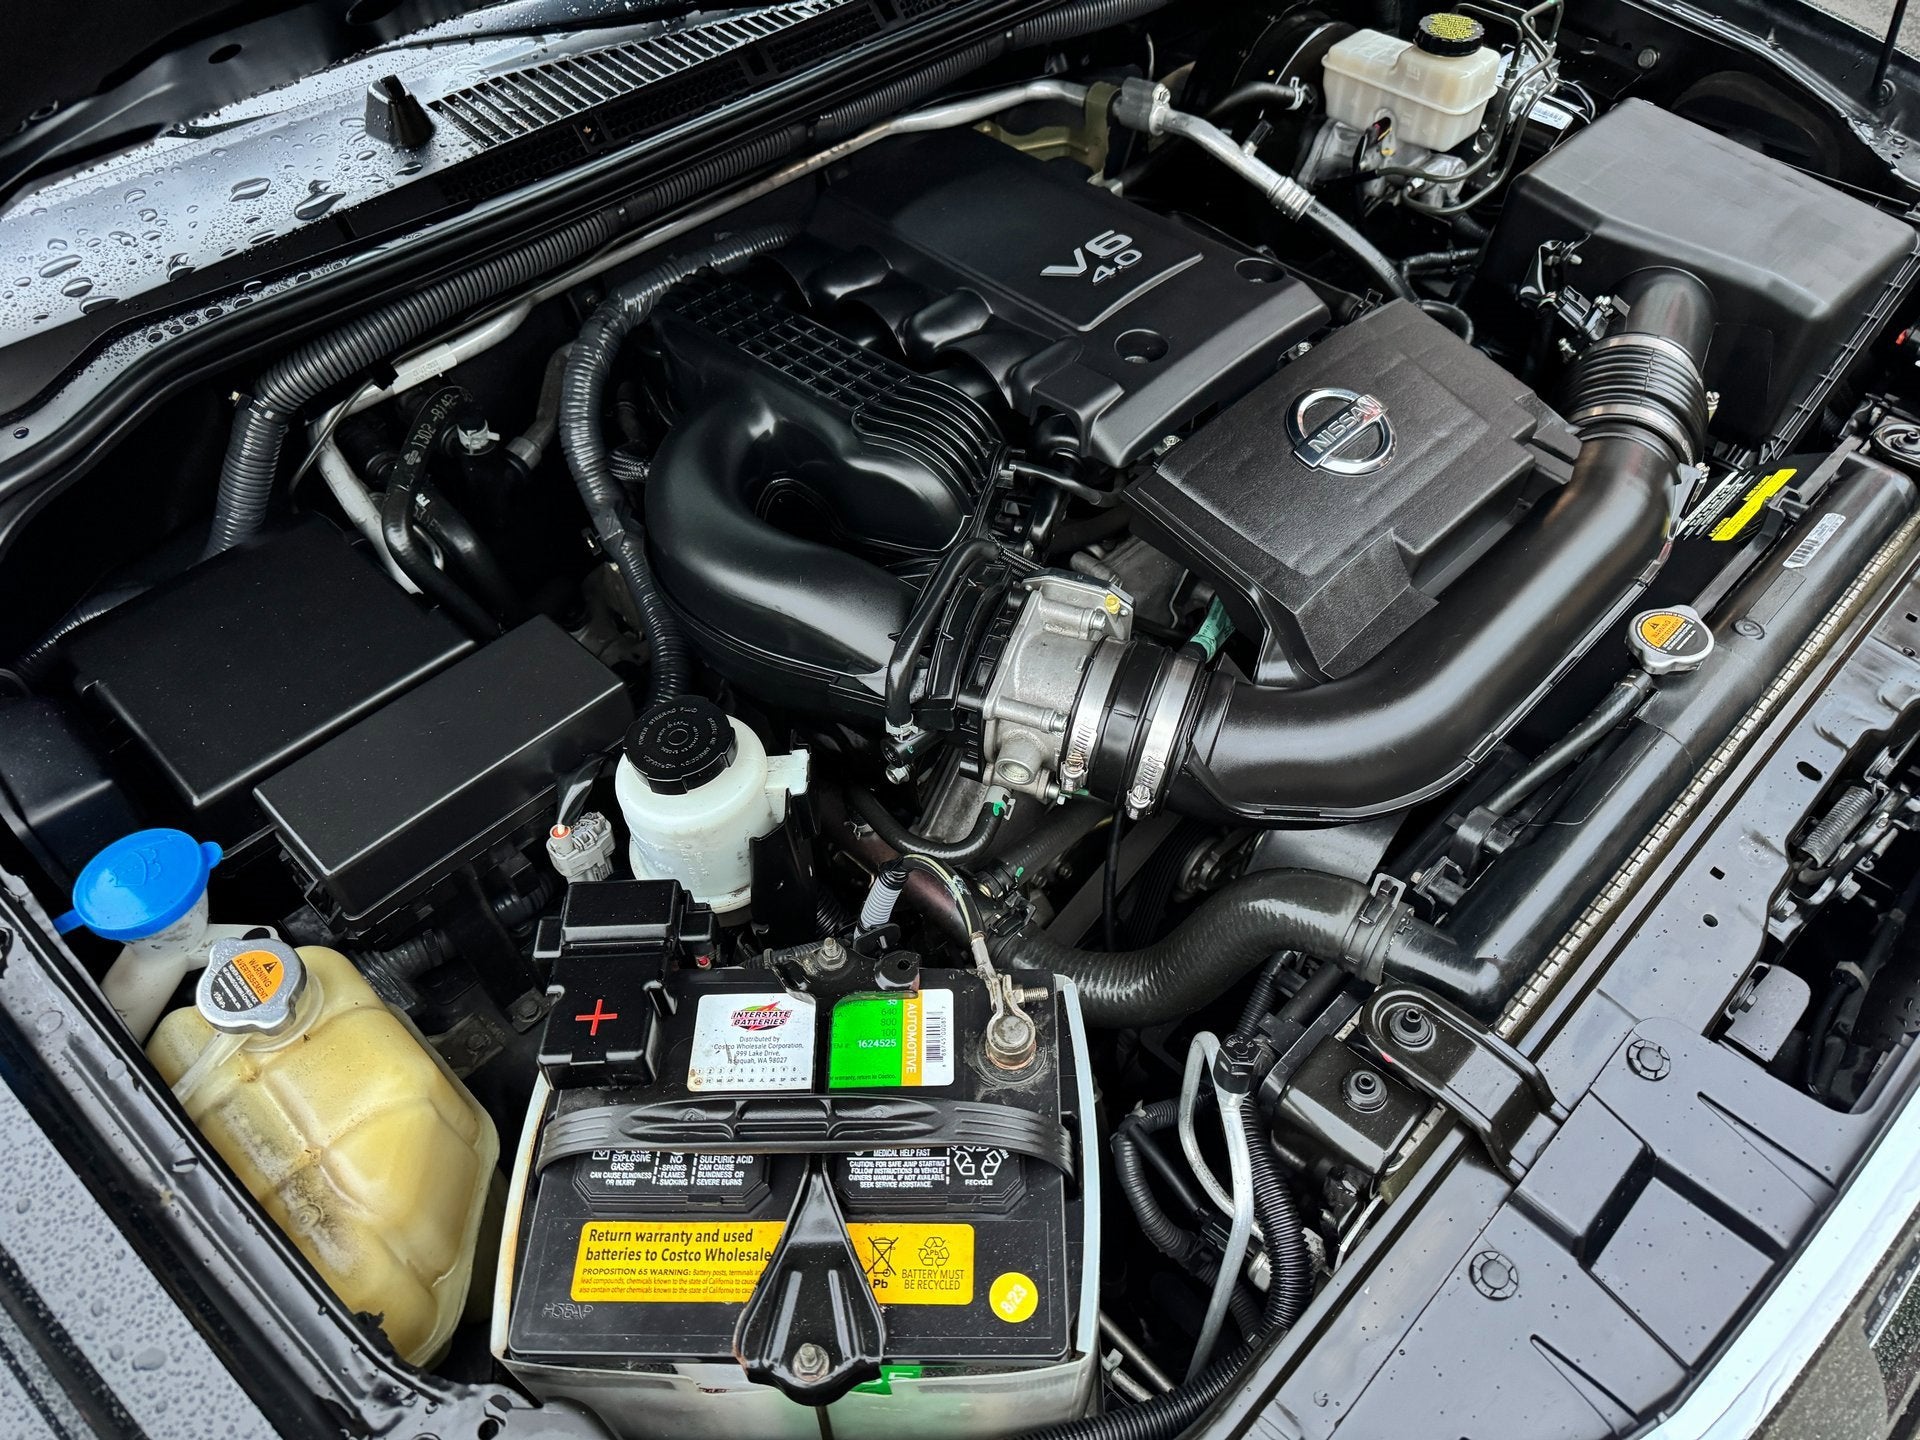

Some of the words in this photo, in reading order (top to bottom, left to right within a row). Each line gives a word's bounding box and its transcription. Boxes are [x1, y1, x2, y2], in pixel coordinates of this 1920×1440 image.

[1040, 230, 1133, 277] V6
[1092, 249, 1143, 286] 4.0
[1308, 397, 1381, 454] NISSAN
[248, 957, 273, 988] WARNING
[236, 958, 268, 1000] AVERTISSEMENT
[732, 1010, 792, 1018] INTERSTATE
[733, 1018, 786, 1026] BATTERIES
[882, 1029, 897, 1037] 100
[906, 1003, 918, 1074] AUTOMOTIVE
[858, 1039, 897, 1048] 1624525
[769, 1056, 788, 1064] 98027
[873, 1149, 899, 1157] MEDICAL
[900, 1149, 915, 1157] HELP
[916, 1149, 931, 1157] FAST
[612, 1154, 652, 1163] EXPLOSIVE
[669, 1155, 683, 1164] NO
[700, 1155, 735, 1164] SULFURIC
[736, 1155, 754, 1164] ACID
[611, 1162, 635, 1171] GASES
[590, 1171, 602, 1179] CAN
[696, 1178, 720, 1186] SEVERE
[721, 1178, 743, 1186] BURNS
[589, 1229, 632, 1242] Return
[636, 1230, 693, 1246] warranty
[695, 1228, 720, 1243] and
[723, 1228, 754, 1243] used
[586, 1247, 641, 1261] batteries
[645, 1248, 658, 1261] to
[661, 1248, 701, 1262] Costco
[705, 1247, 772, 1262] Wholesale
[650, 1268, 691, 1276] WARNING:
[693, 1269, 711, 1277] Battery
[901, 1269, 939, 1279] BATTERY
[940, 1269, 965, 1279] MUST
[872, 1279, 888, 1289] Pb
[904, 1280, 916, 1289] BE
[917, 1280, 960, 1290] RECYCLED
